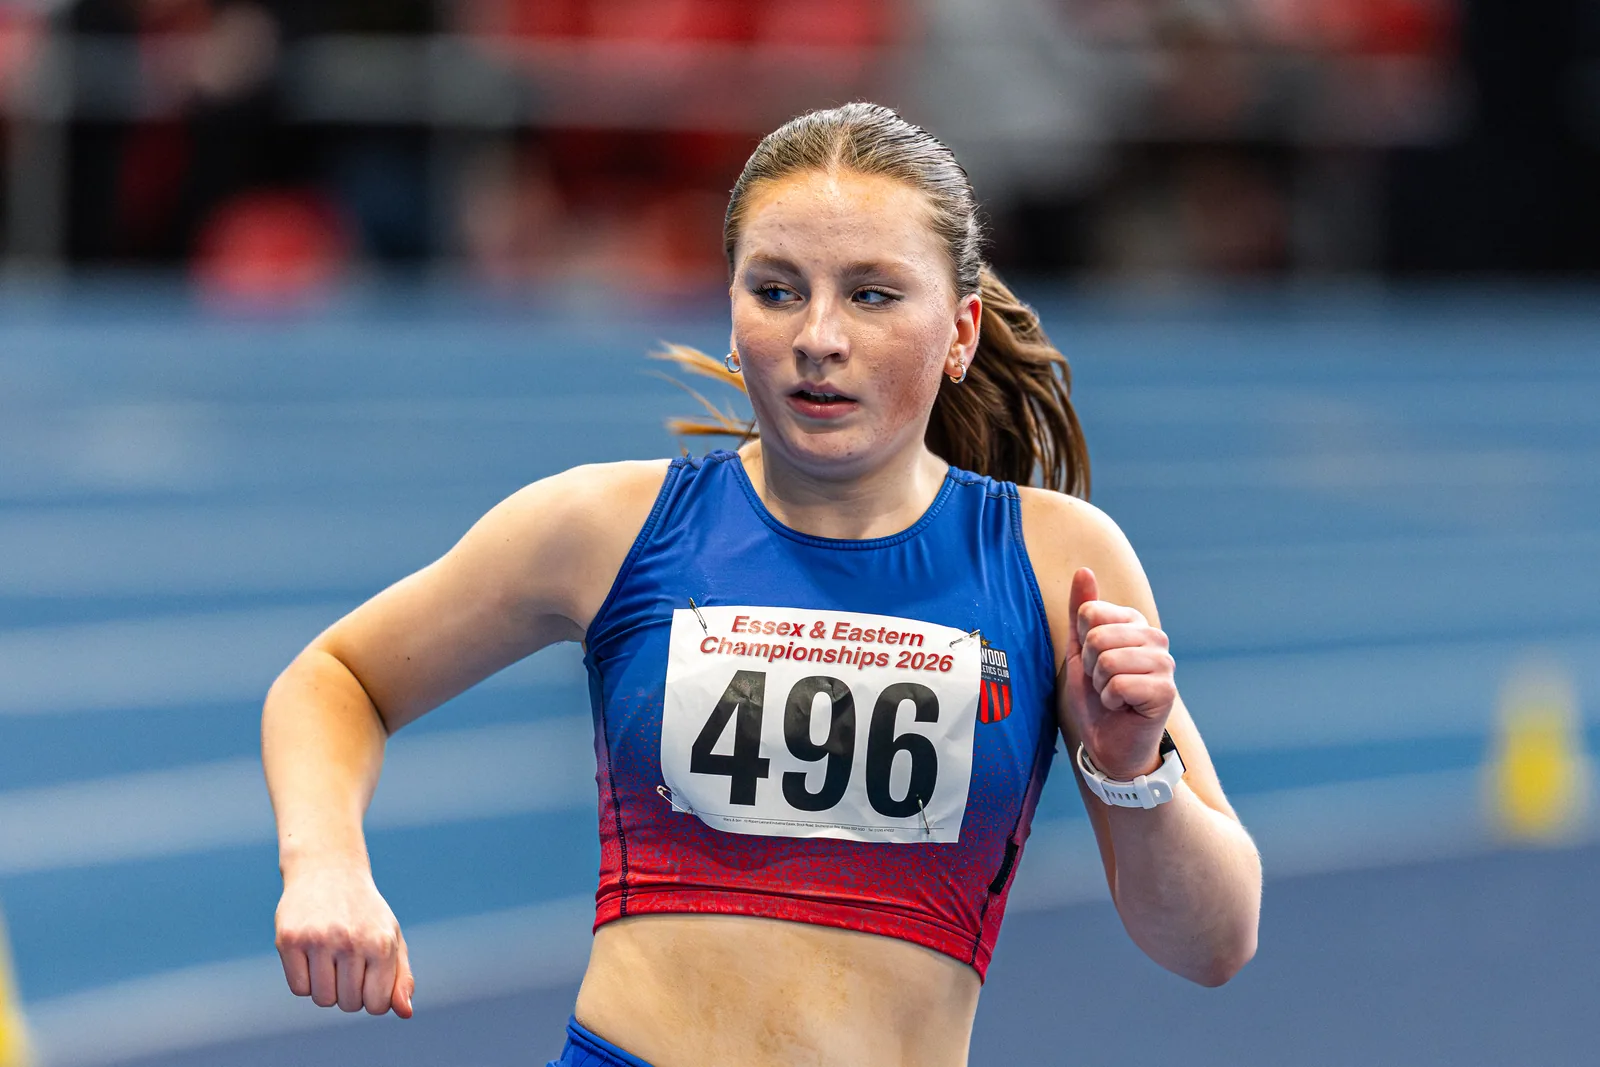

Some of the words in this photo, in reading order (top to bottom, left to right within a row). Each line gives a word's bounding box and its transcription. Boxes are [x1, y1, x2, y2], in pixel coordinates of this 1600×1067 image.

[731, 615, 805, 637] Essex
[809, 620, 827, 639] &
[832, 621, 925, 647] Eastern
[699, 635, 889, 670] Championships
[895, 650, 954, 673] 2026
[981, 665, 997, 675] ETICS
[997, 668, 1009, 678] CLUB
[690, 669, 940, 819] 496
